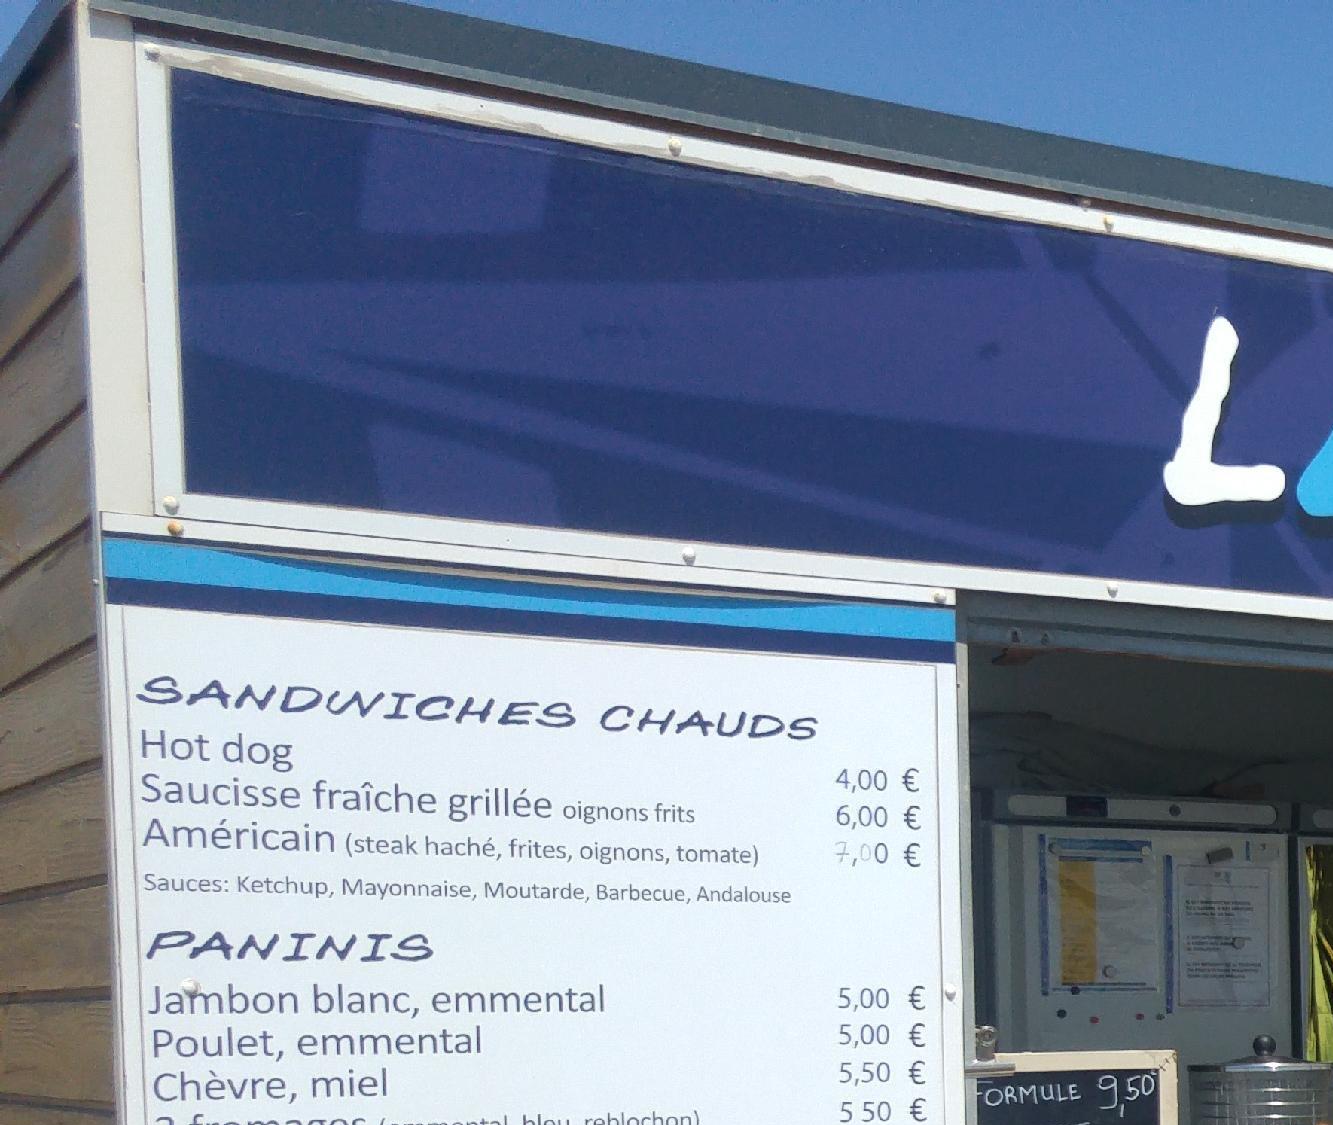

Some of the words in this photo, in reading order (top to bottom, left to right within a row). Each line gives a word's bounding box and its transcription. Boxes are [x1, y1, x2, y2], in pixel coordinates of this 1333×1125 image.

[136, 676, 576, 728] SANDWICHES
[600, 705, 819, 741] CHAUDS
[141, 729, 210, 761] Hot
[222, 733, 293, 773] dog
[141, 773, 300, 808] Saucisse
[312, 780, 437, 813] fraîche
[449, 788, 552, 822] grillée
[563, 801, 648, 824] oignons
[654, 803, 695, 823] frits
[835, 768, 887, 793] 4,00
[901, 768, 919, 792] €
[837, 805, 888, 830] 6,00
[904, 806, 921, 830] €
[142, 818, 334, 852] Américain
[346, 833, 418, 858] (steak
[425, 835, 502, 861] haché,
[508, 838, 572, 863] frites,
[580, 842, 669, 865] oignons,
[676, 845, 758, 867] tomate)
[144, 874, 228, 892] Sauces:
[238, 876, 334, 898] Ketchup,
[342, 878, 477, 901] Mayonnaise,
[485, 882, 589, 903] Moutarde,
[597, 884, 691, 904] Barbecue,
[697, 886, 791, 903] Andalouse
[146, 931, 434, 962] PANINIS
[148, 983, 298, 1014] Jambon
[313, 984, 419, 1019] blanc,
[432, 984, 604, 1013] emmental
[838, 988, 889, 1012] 5,00
[908, 986, 925, 1010] €
[154, 1070, 297, 1104] Chèvre,
[312, 1068, 387, 1098] miel
